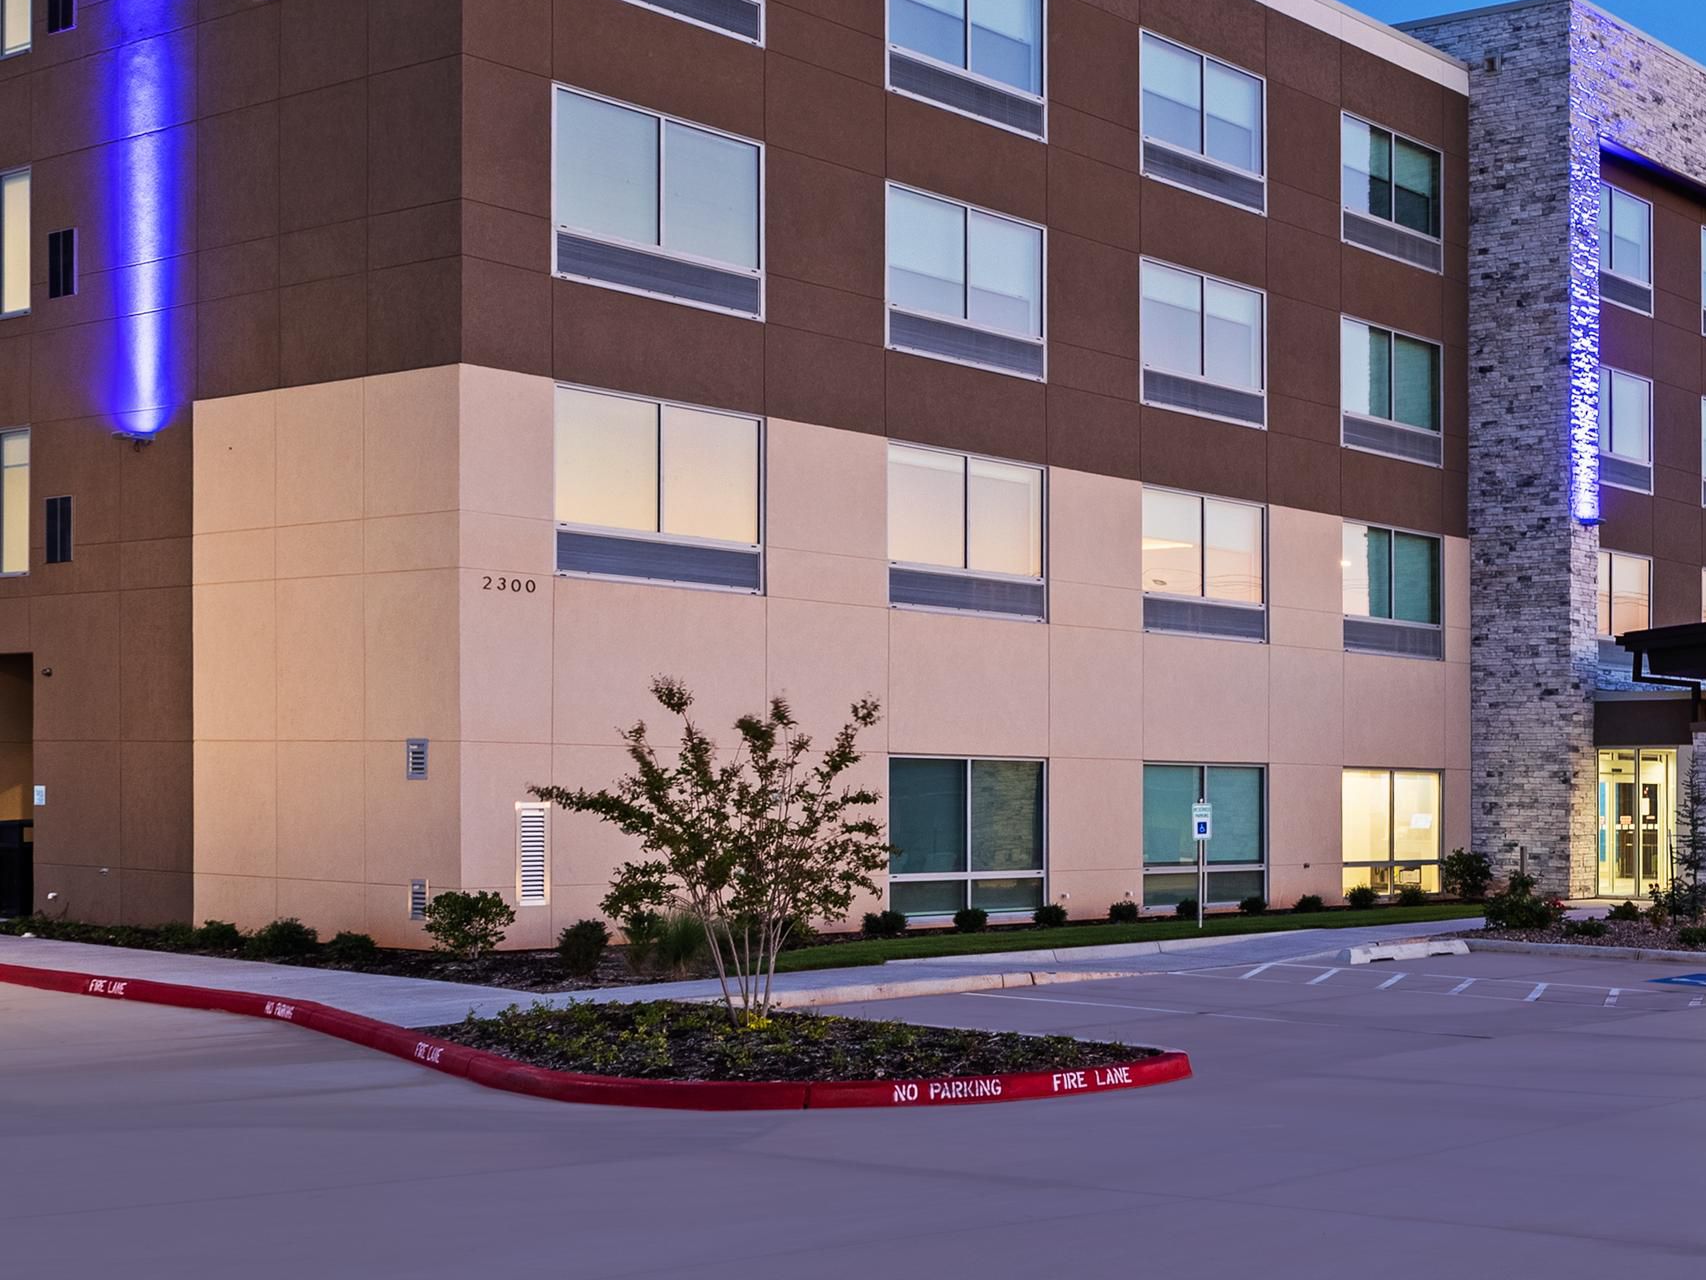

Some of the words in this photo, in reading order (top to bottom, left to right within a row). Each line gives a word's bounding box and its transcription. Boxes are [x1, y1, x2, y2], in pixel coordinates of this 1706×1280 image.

[482, 575, 537, 594] 2300
[893, 1083, 919, 1102] NO
[929, 1078, 1003, 1100] PARKING
[1052, 1071, 1088, 1092] FIRE
[1096, 1066, 1133, 1086] LANE
